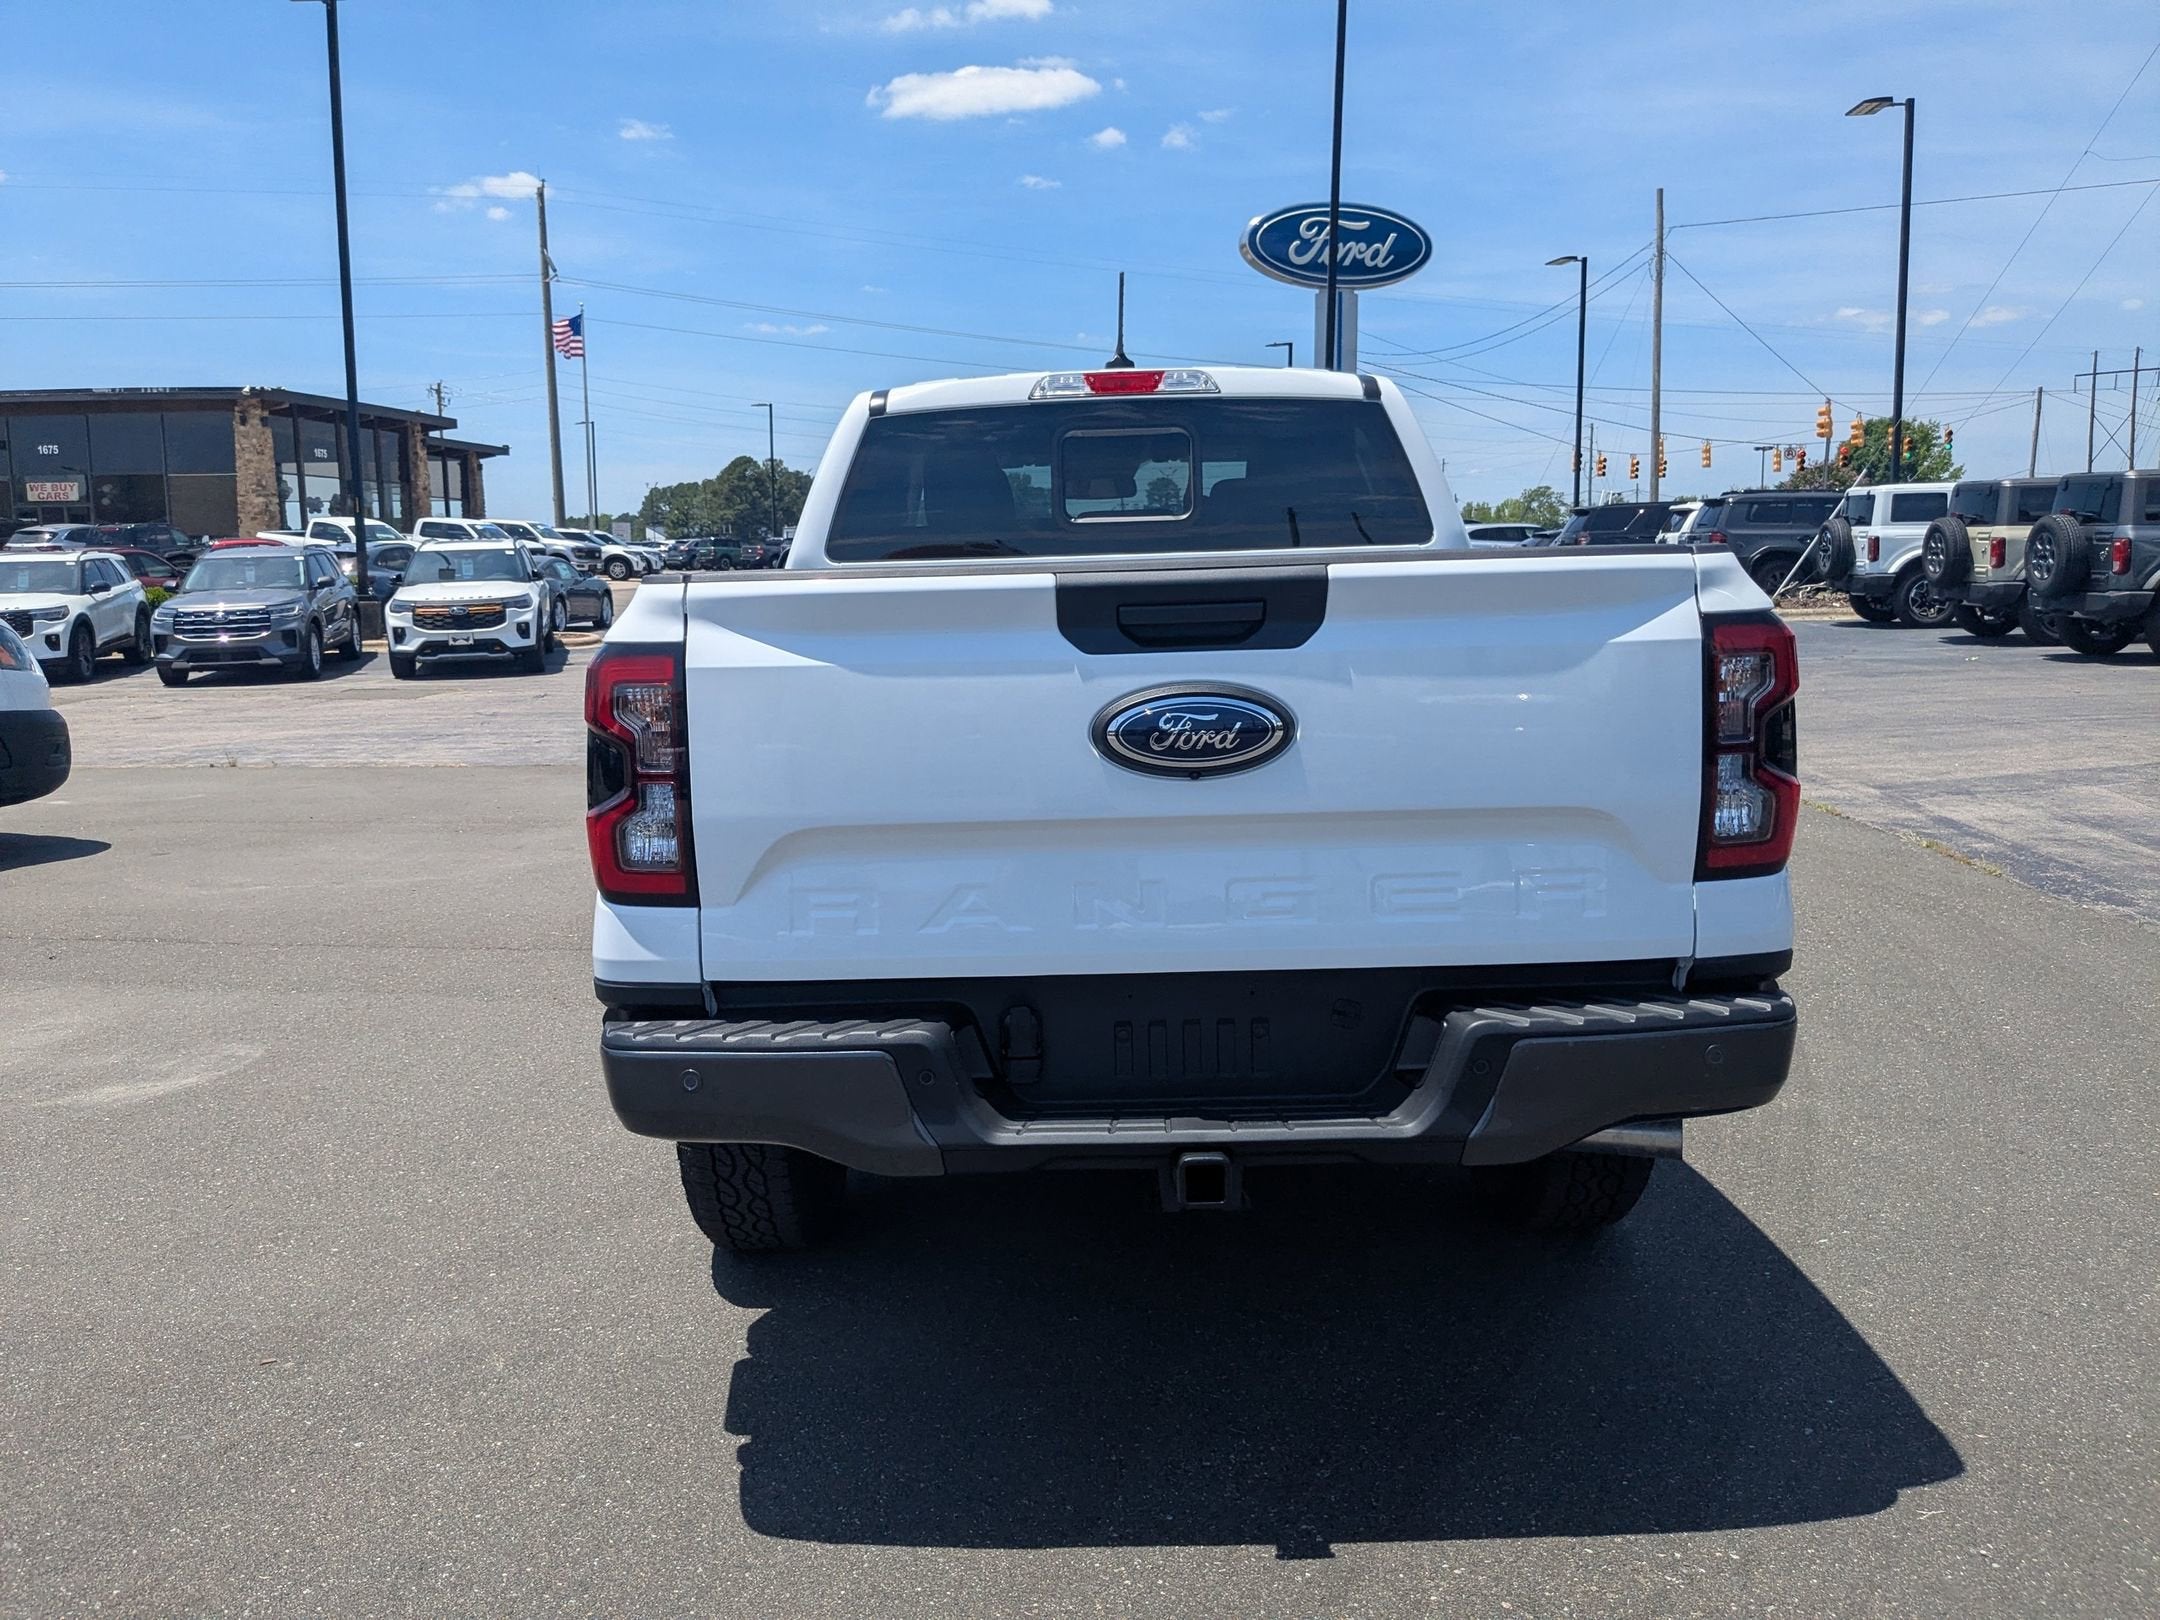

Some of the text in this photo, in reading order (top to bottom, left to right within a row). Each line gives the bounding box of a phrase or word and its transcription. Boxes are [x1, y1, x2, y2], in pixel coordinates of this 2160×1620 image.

[37, 445, 59, 455] 1675
[314, 448, 328, 459] 1675
[29, 482, 76, 492] WE BUY
[37, 492, 70, 500] CARS
[1149, 712, 1242, 752] Ford
[789, 867, 1607, 936] RANGER
